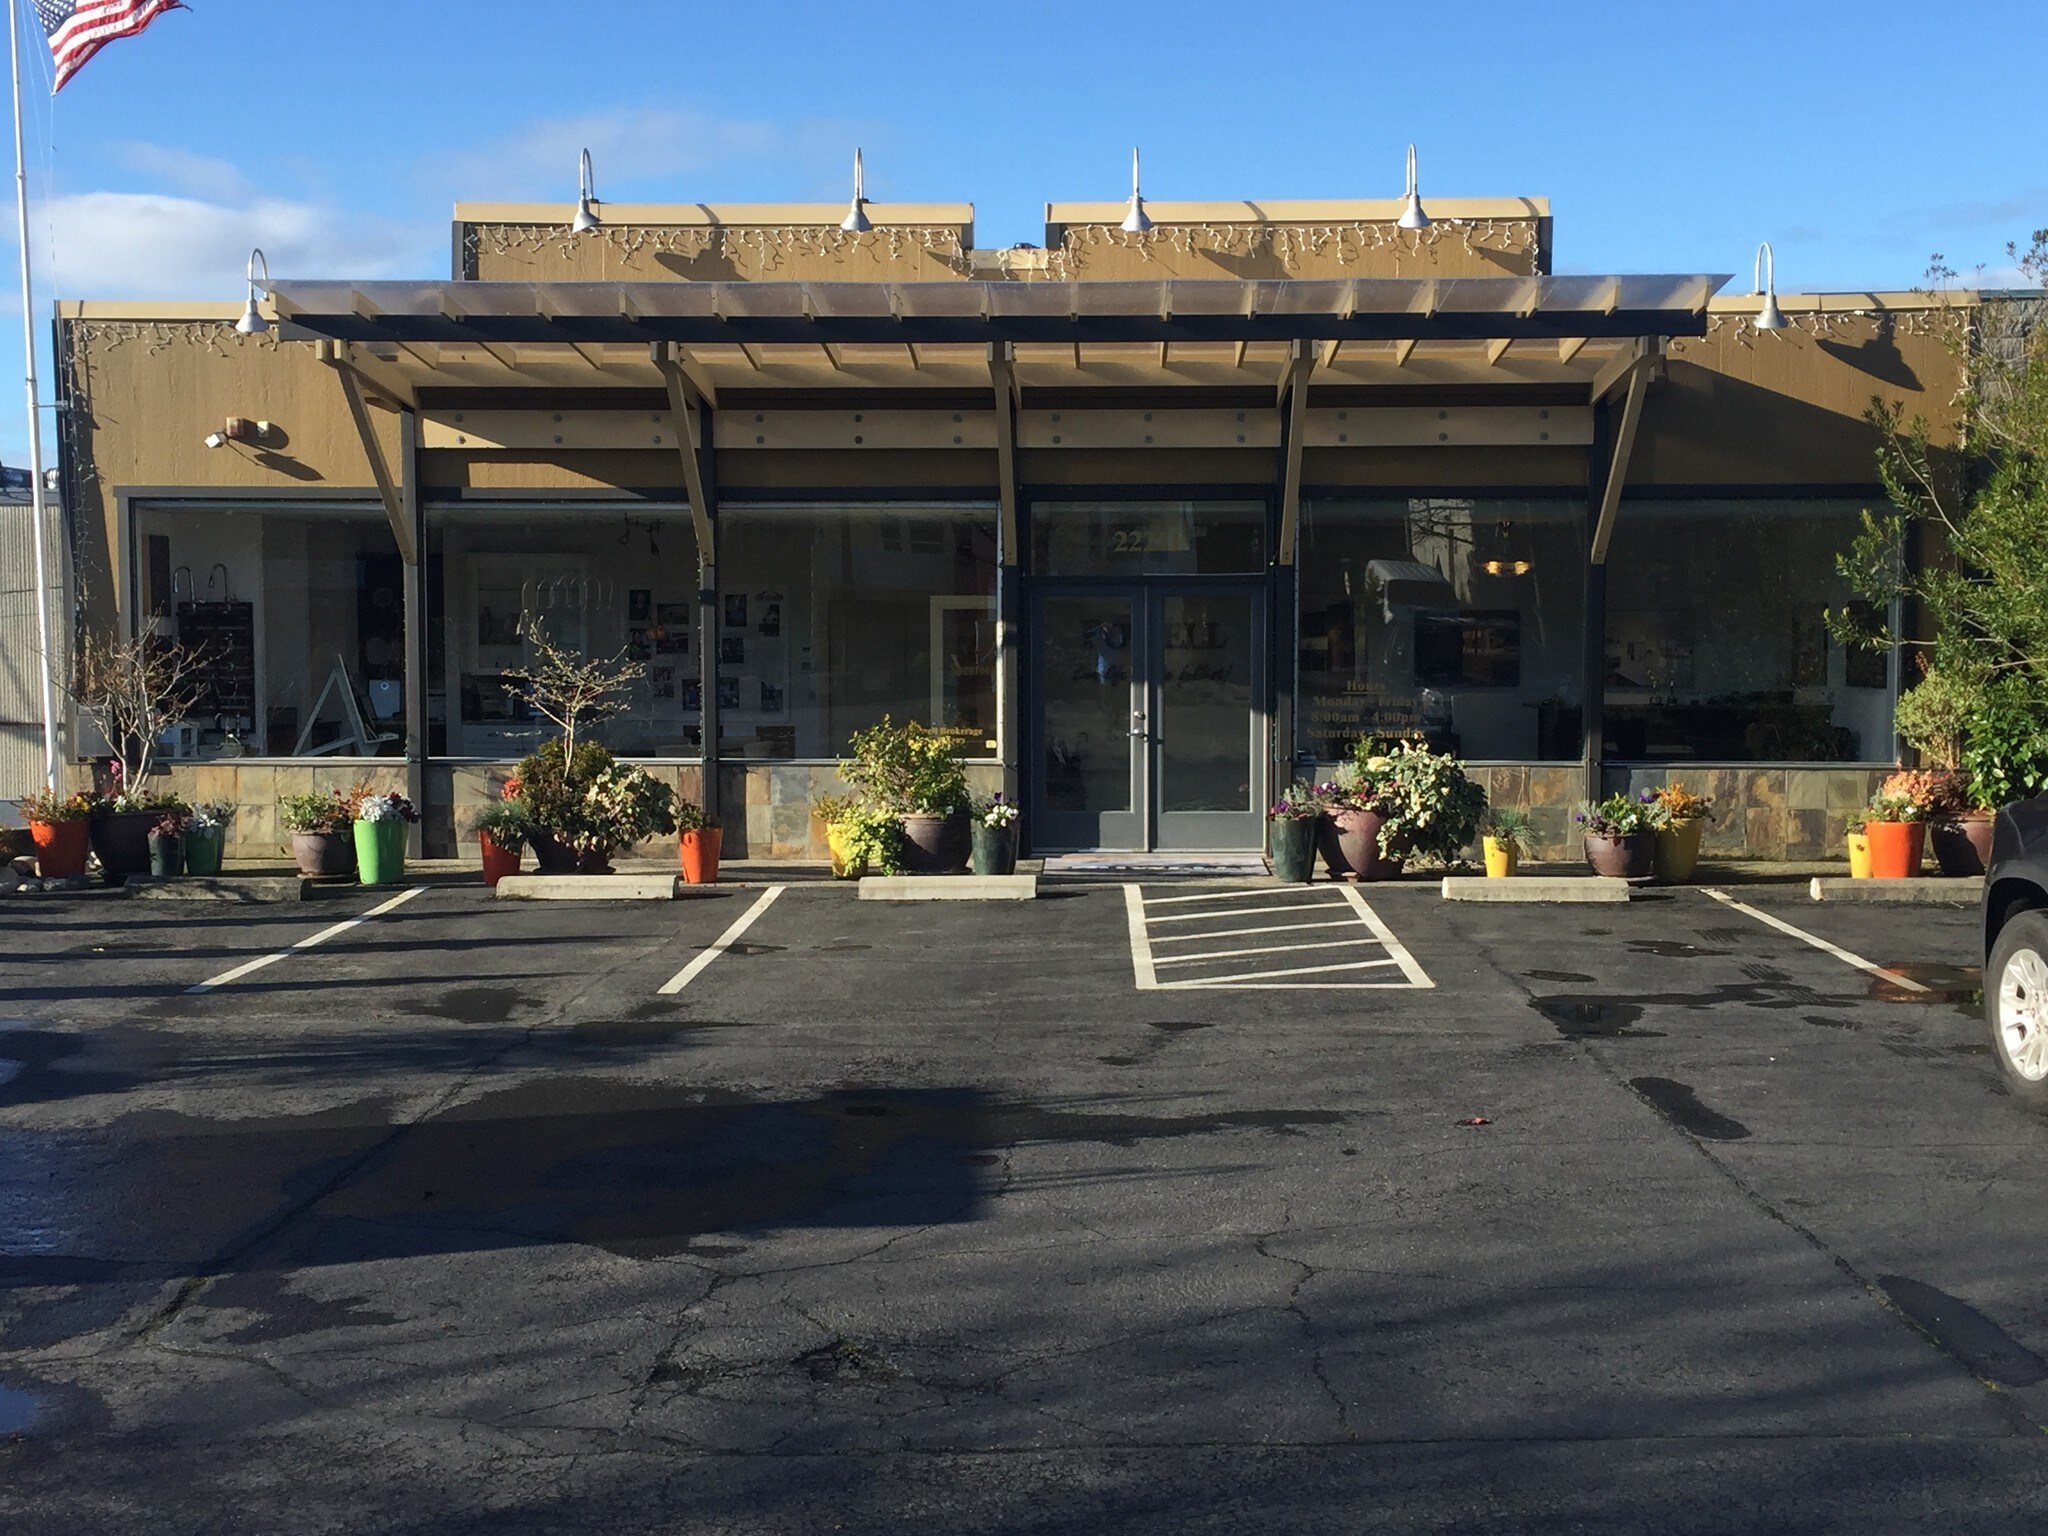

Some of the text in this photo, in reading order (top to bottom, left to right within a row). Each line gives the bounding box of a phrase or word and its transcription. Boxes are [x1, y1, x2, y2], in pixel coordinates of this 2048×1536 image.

[1347, 680, 1387, 691] Hours
[1312, 696, 1366, 709] Monday
[1378, 696, 1419, 709] Friday
[940, 727, 984, 737] Brokerage
[1306, 727, 1366, 740] Saturday
